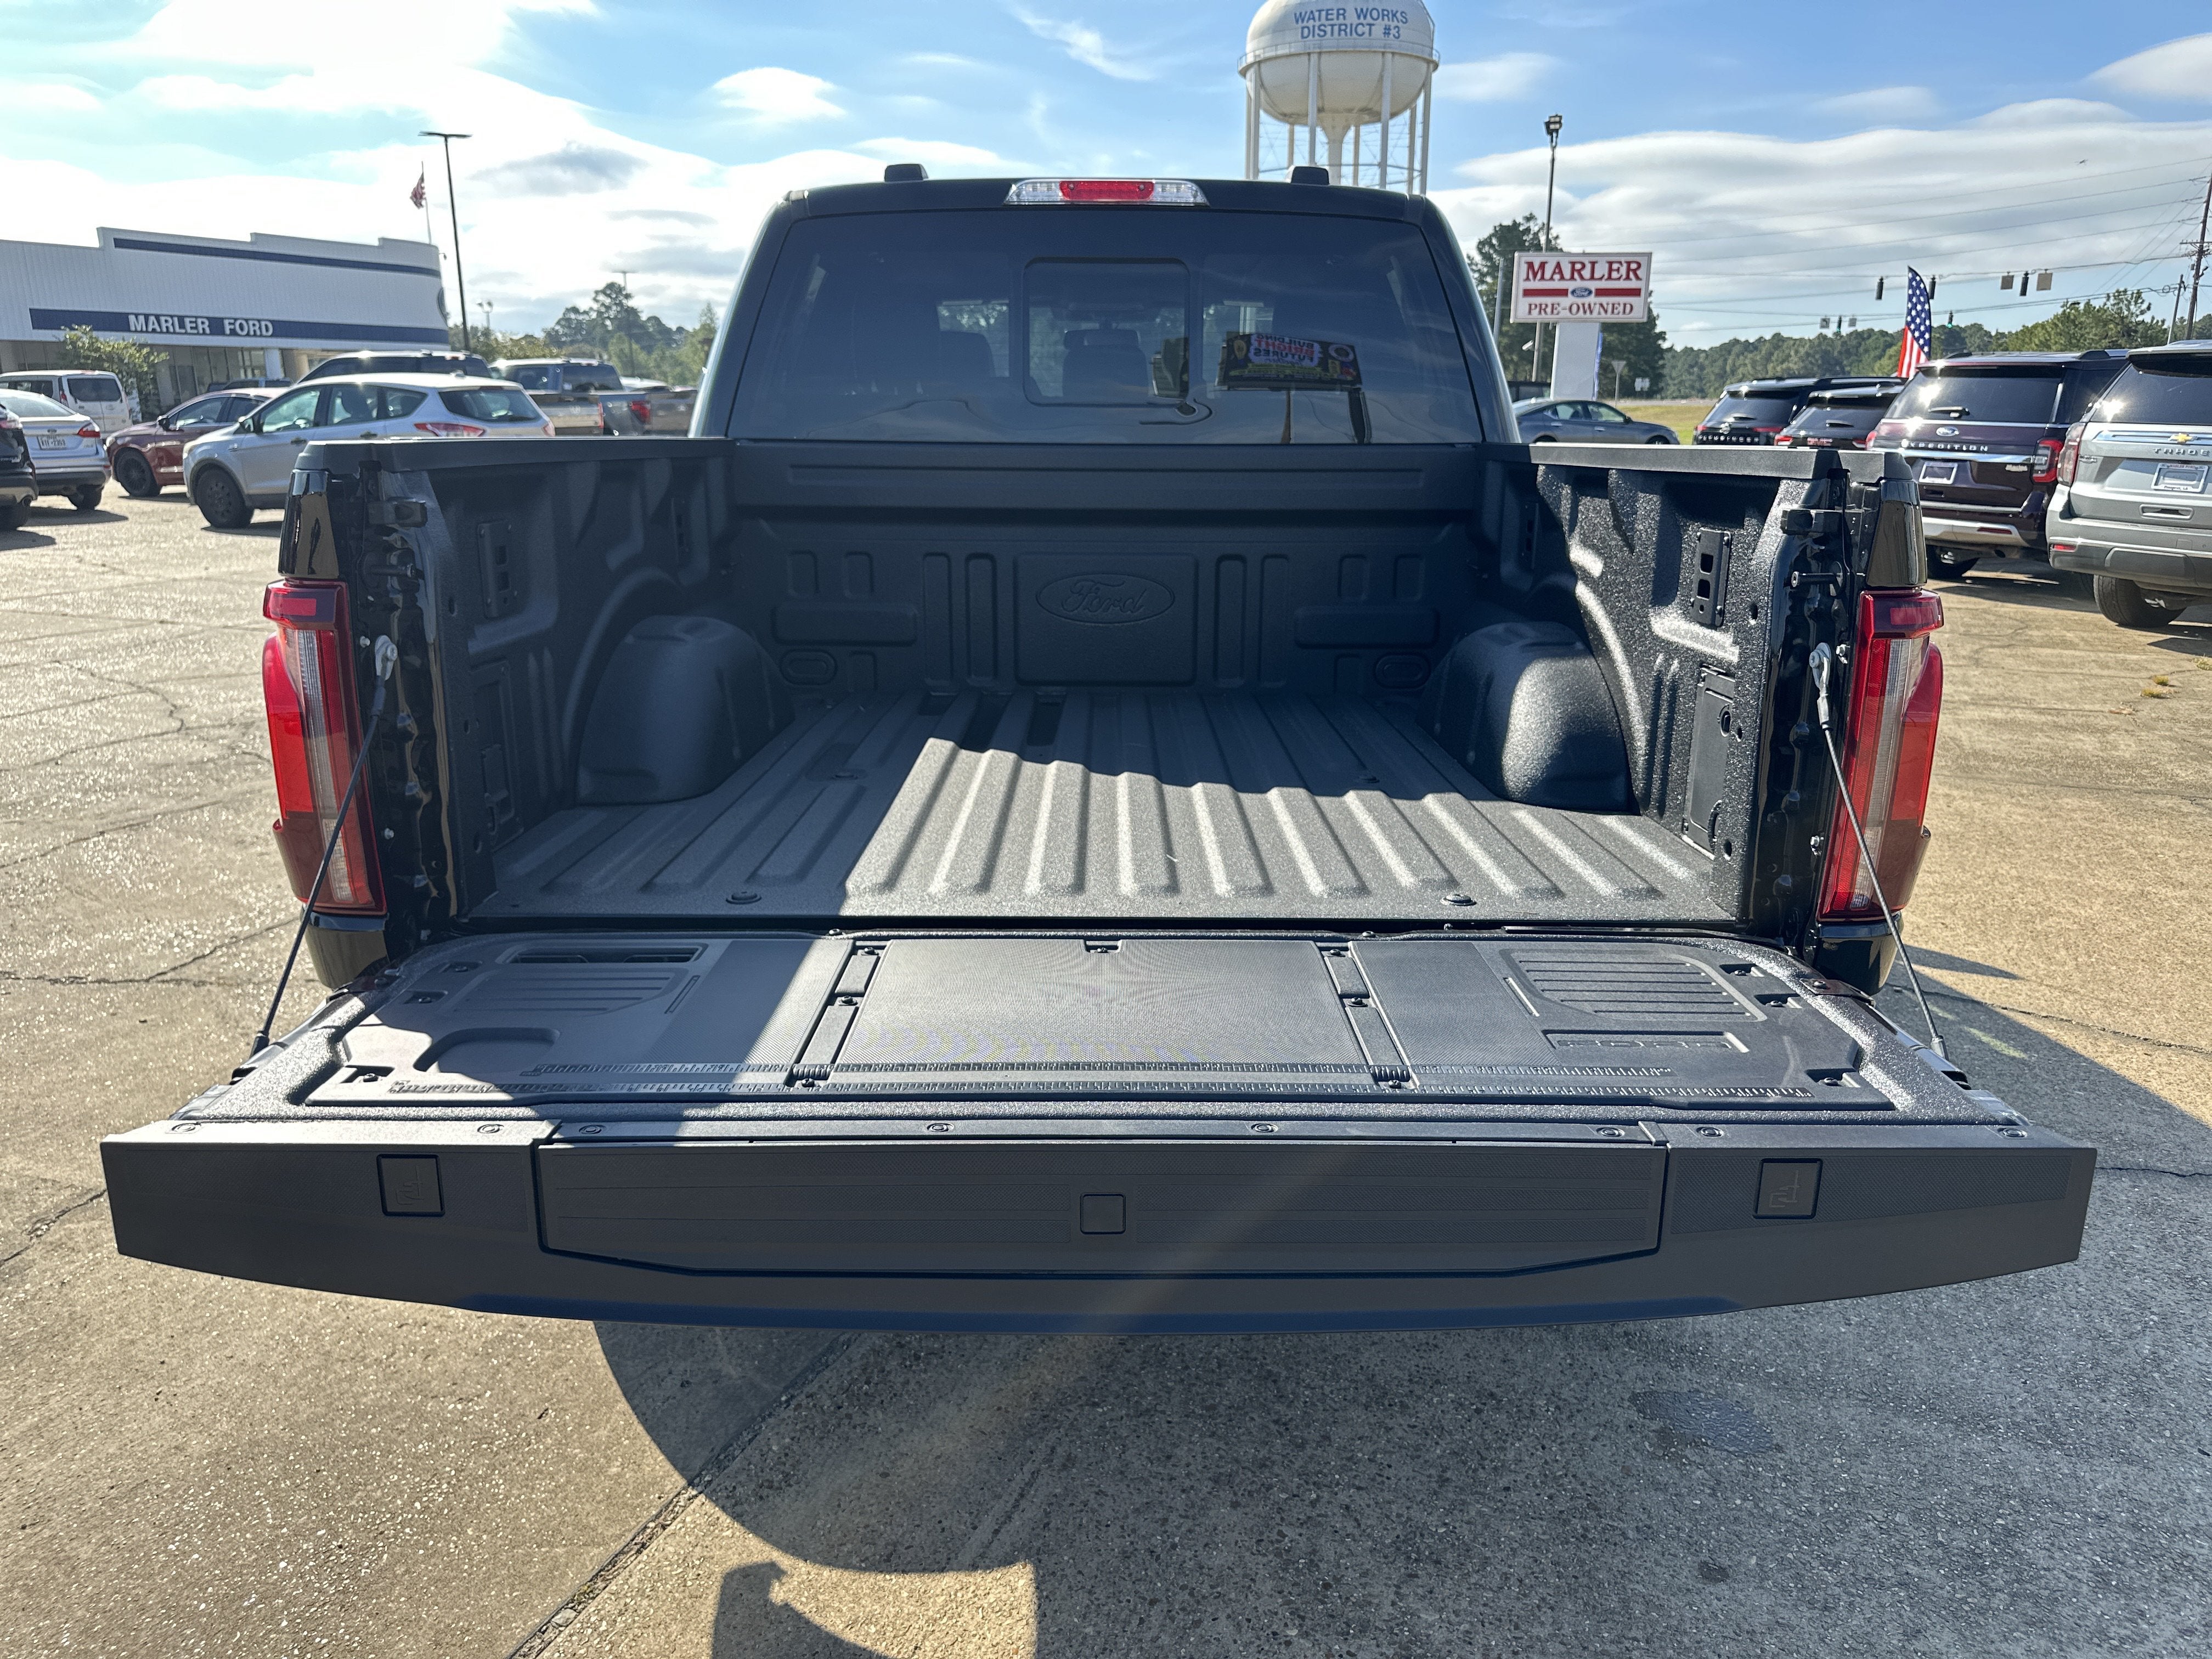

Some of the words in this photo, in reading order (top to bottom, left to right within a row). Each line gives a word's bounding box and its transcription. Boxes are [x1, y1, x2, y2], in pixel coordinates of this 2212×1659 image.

[1294, 8, 1346, 25] WATER
[1355, 7, 1409, 25] WORKS
[1300, 23, 1374, 40] DISTRICT
[1383, 25, 1401, 40] #3
[1523, 261, 1643, 281] MARLER
[1527, 302, 1634, 316] PRE-OWNED
[128, 314, 211, 335] MARLER
[223, 318, 274, 337] FORD
[1902, 440, 1988, 452] XPEDITION
[2153, 447, 2210, 456] TAHOE
[1062, 578, 1147, 614] Ford
